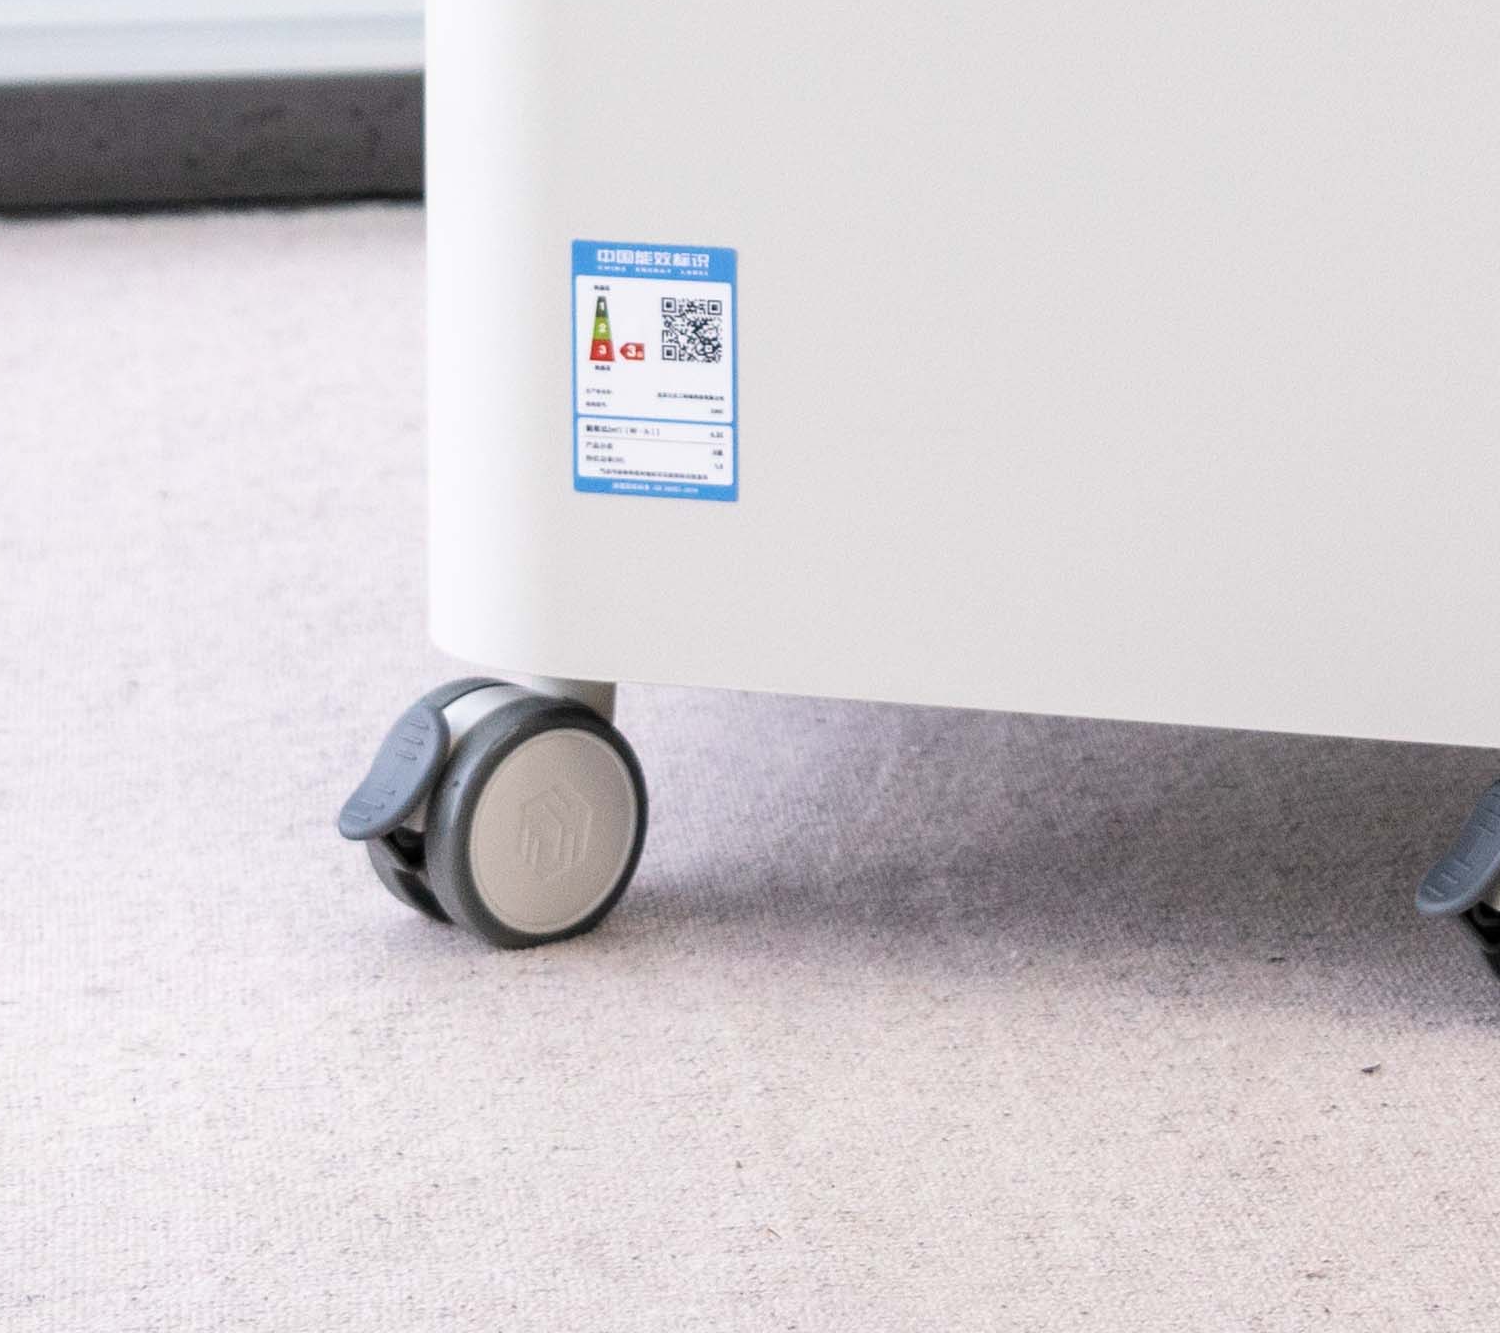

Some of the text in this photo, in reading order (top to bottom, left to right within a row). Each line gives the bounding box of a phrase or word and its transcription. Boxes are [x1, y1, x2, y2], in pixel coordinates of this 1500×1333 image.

[597, 249, 710, 268] 中国能效标识
[598, 323, 607, 333] 2
